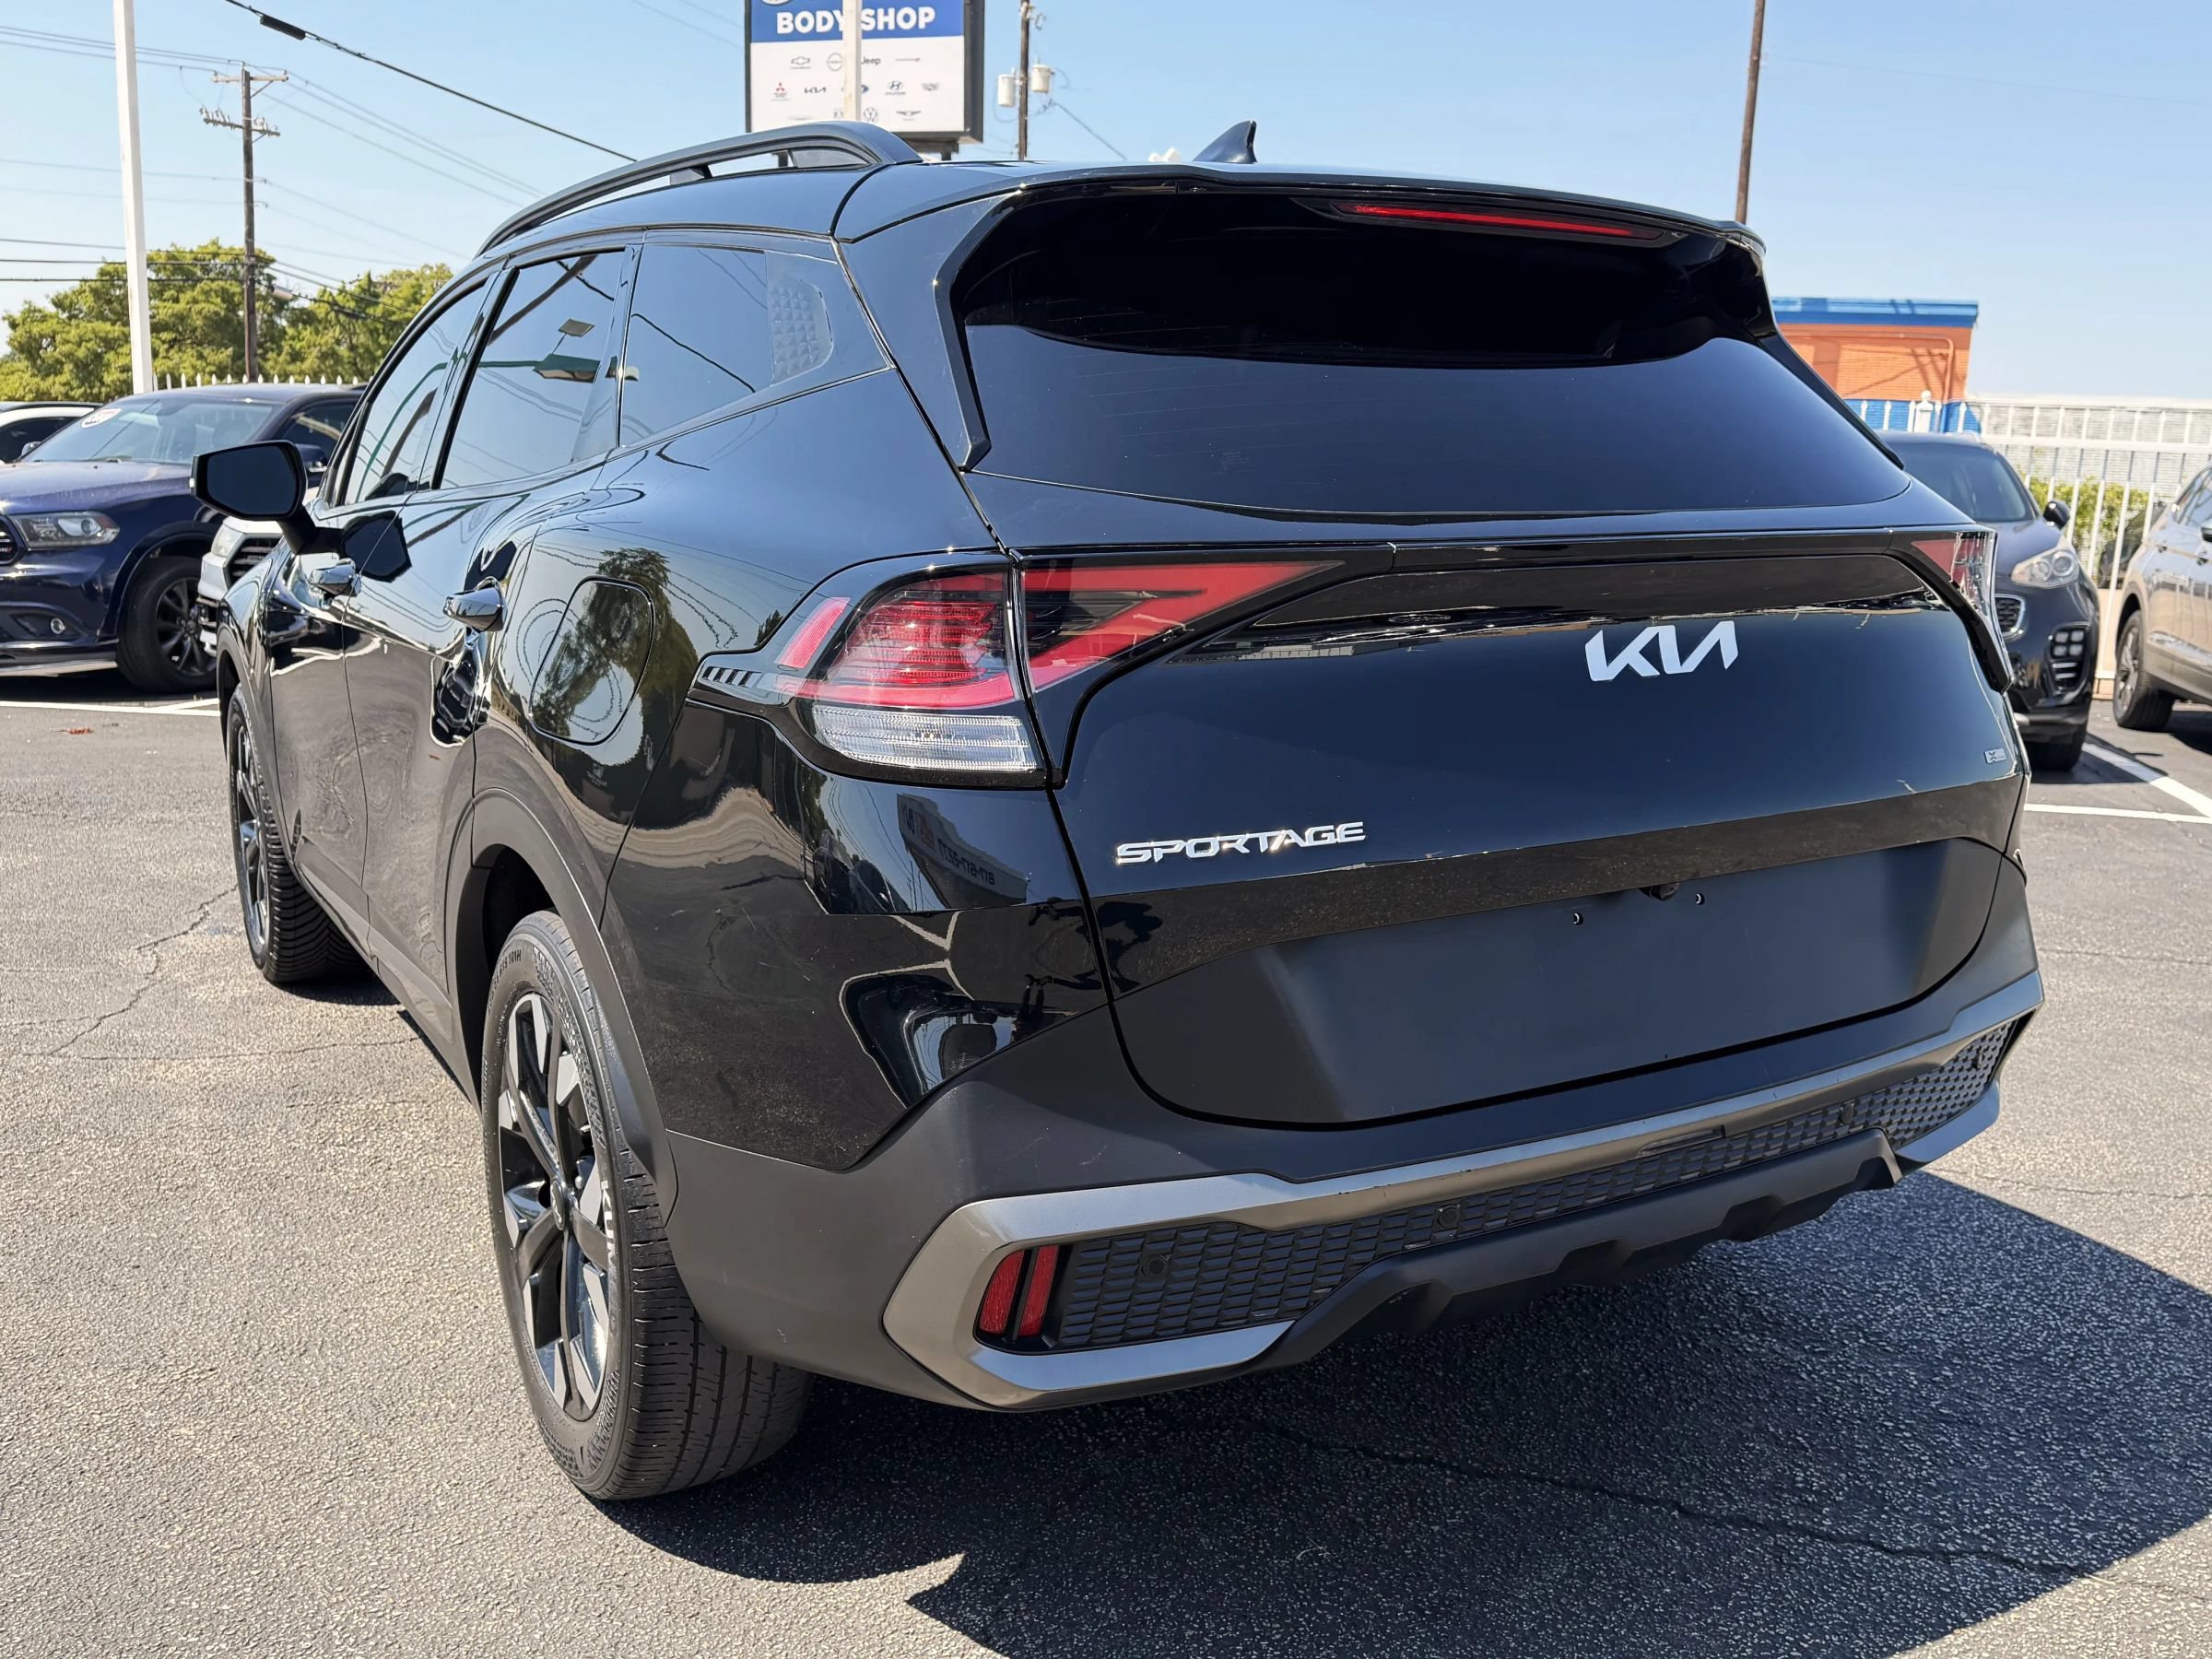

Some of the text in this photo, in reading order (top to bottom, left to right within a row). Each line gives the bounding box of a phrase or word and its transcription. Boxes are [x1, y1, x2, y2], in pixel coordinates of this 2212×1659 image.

[861, 6, 935, 31] SHOP
[1584, 620, 1738, 682] KIA
[1116, 821, 1366, 863] SPORTAGE
